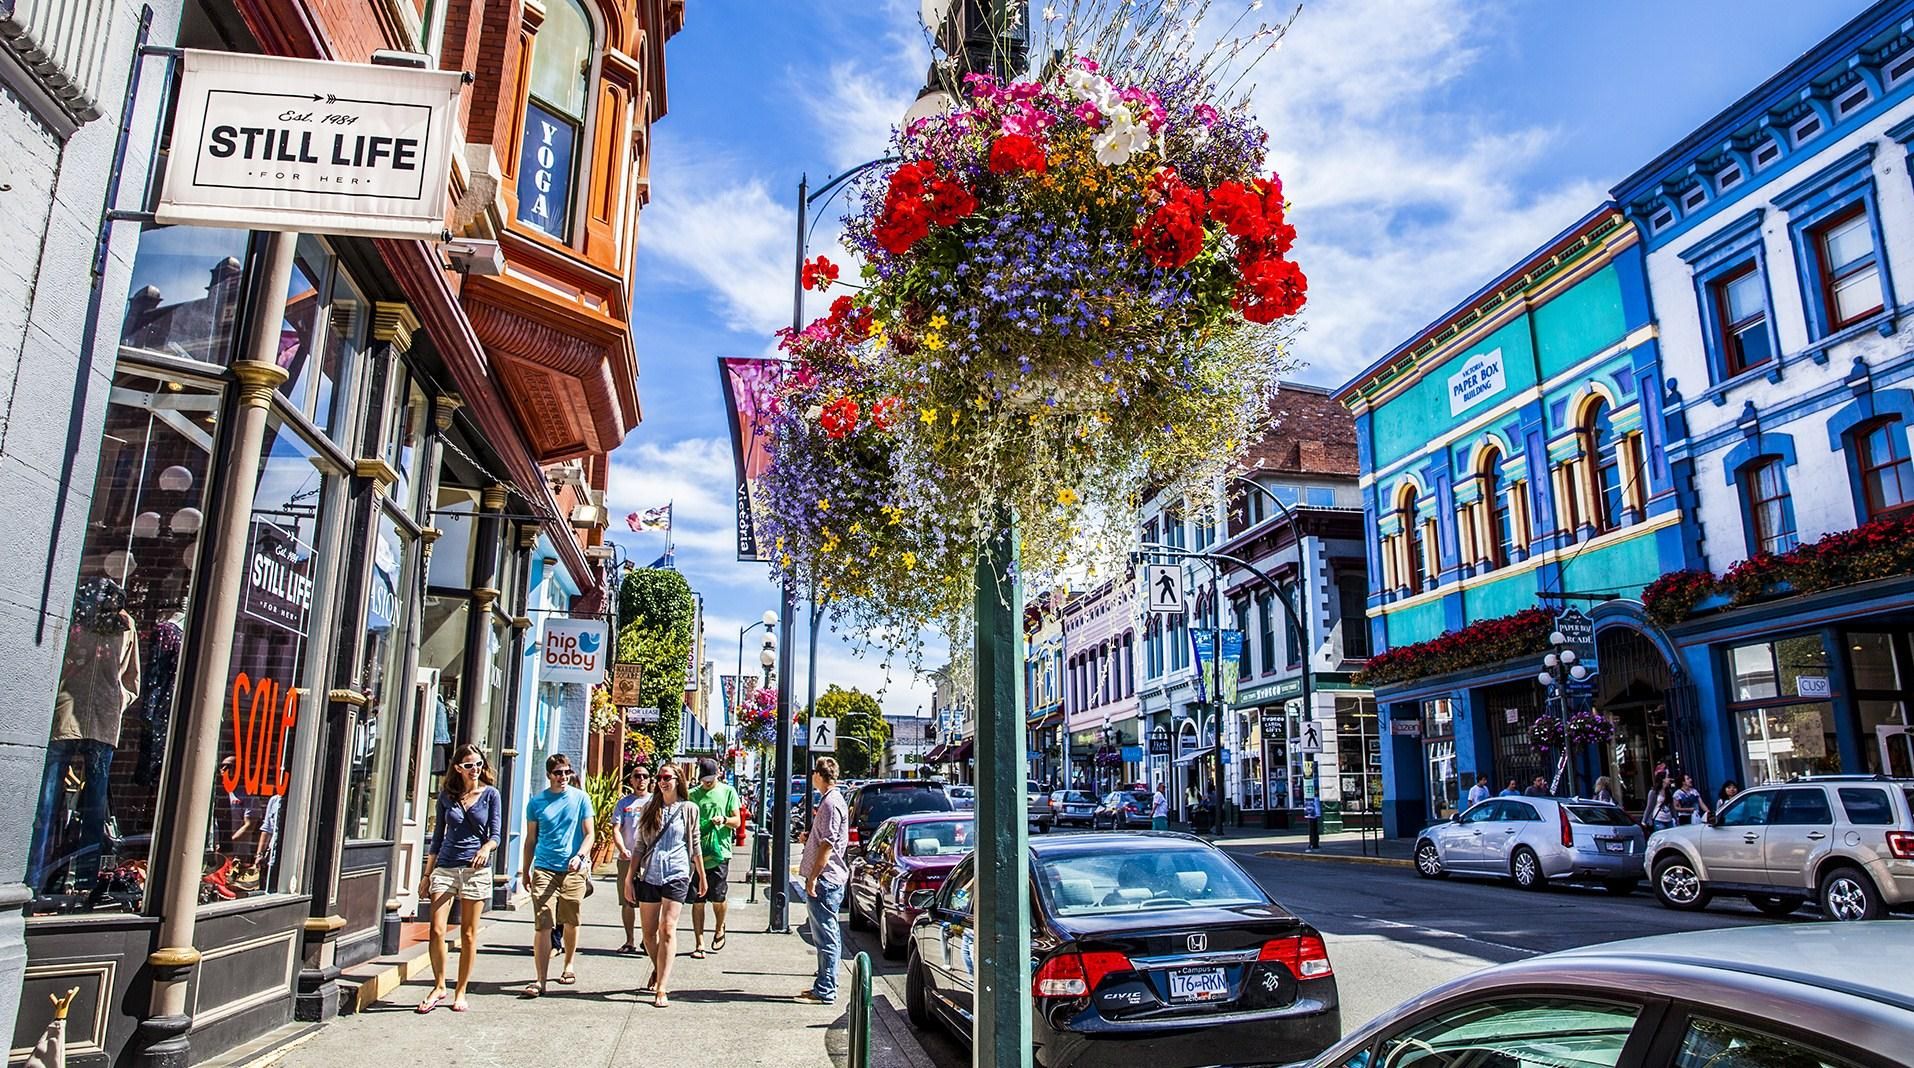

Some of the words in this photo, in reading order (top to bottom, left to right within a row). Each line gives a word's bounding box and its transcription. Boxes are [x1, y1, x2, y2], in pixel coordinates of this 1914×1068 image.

[278, 110, 313, 123] Est.
[321, 113, 360, 126] 1984
[209, 125, 318, 164] STILL
[331, 134, 418, 170] LIFE
[260, 171, 300, 180] FOR
[320, 176, 359, 185] HER
[531, 120, 557, 219] YOGA
[1453, 374, 1478, 397] PAPER
[1480, 361, 1499, 381] BOX
[1462, 361, 1484, 377] VICTORIA
[1463, 380, 1492, 402] BUILDING
[738, 483, 752, 551] Victoria
[252, 553, 285, 598] STILL
[286, 570, 313, 610] LIFE
[263, 603, 278, 613] FOR
[280, 609, 294, 620] HER
[1559, 624, 1579, 632] PAPER
[547, 631, 577, 652] hip
[546, 648, 595, 671] baby
[1801, 680, 1826, 691] CUSP
[1172, 976, 1195, 993] 176
[1201, 974, 1227, 991] RKN
[1103, 991, 1141, 1000] CIVIC
